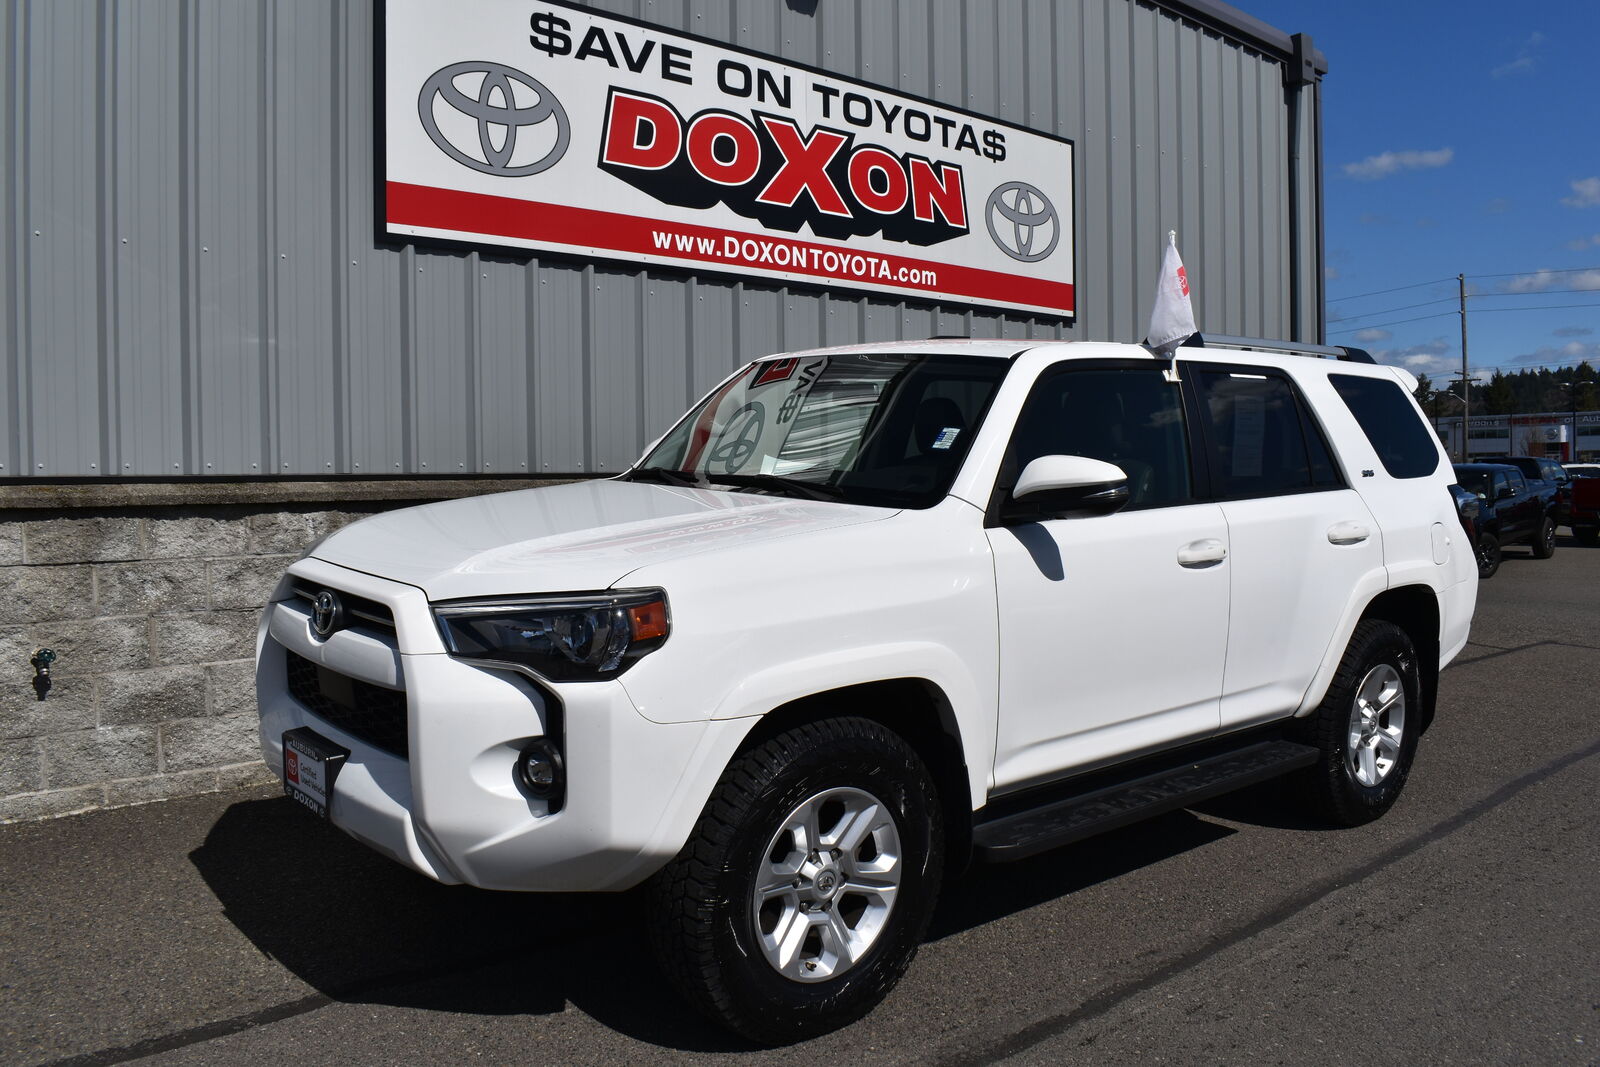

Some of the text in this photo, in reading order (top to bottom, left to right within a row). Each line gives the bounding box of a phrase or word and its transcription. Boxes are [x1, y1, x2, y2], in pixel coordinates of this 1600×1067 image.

[529, 12, 1006, 163] $AVE ON TOYOTA$
[599, 84, 969, 240] DOXON
[652, 230, 938, 287] www.DOXONTOYOTA.com
[293, 789, 319, 814] DOXON
